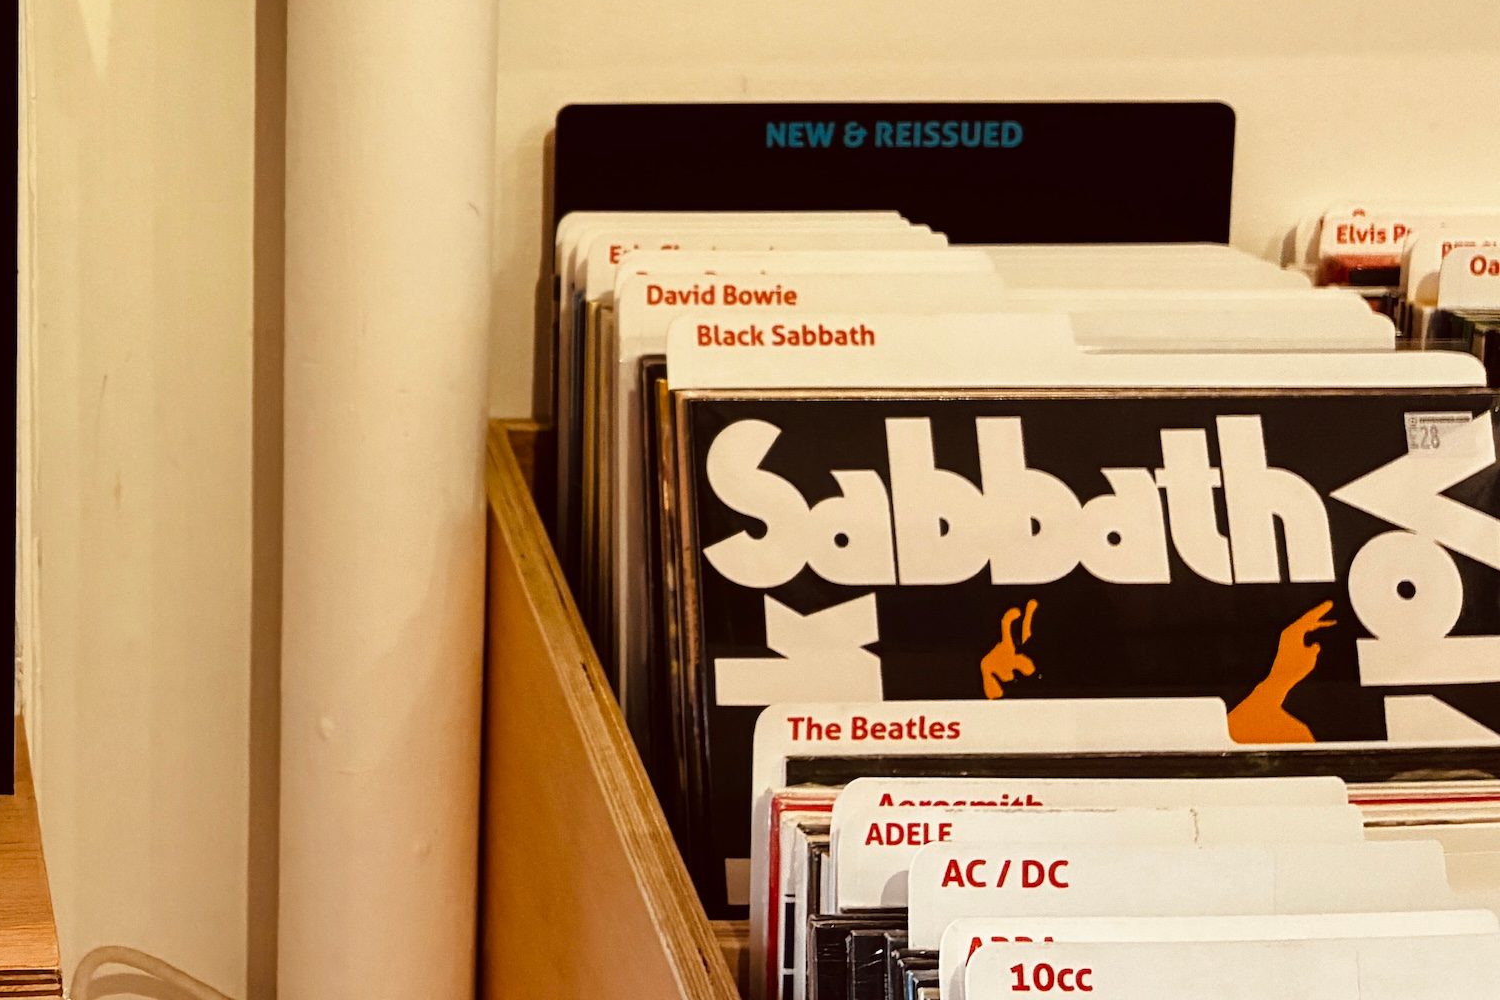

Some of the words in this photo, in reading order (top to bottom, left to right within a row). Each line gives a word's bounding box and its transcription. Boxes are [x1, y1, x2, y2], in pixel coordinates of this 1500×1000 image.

[766, 121, 836, 148] NEW
[843, 121, 868, 148] &
[874, 120, 1024, 148] REISSUED
[1336, 223, 1387, 245] Elvis
[646, 283, 717, 307] David
[723, 283, 798, 307] Bowie
[697, 323, 766, 348] Black
[772, 323, 877, 348] Sabbath
[703, 415, 1335, 588] Sabbath
[787, 716, 843, 742] The
[850, 715, 961, 742] Beatles
[865, 822, 953, 846] ADELE
[941, 859, 987, 888] AC
[996, 859, 1012, 888] /
[1021, 860, 1069, 888] DC
[1010, 963, 1093, 991] 10cc
